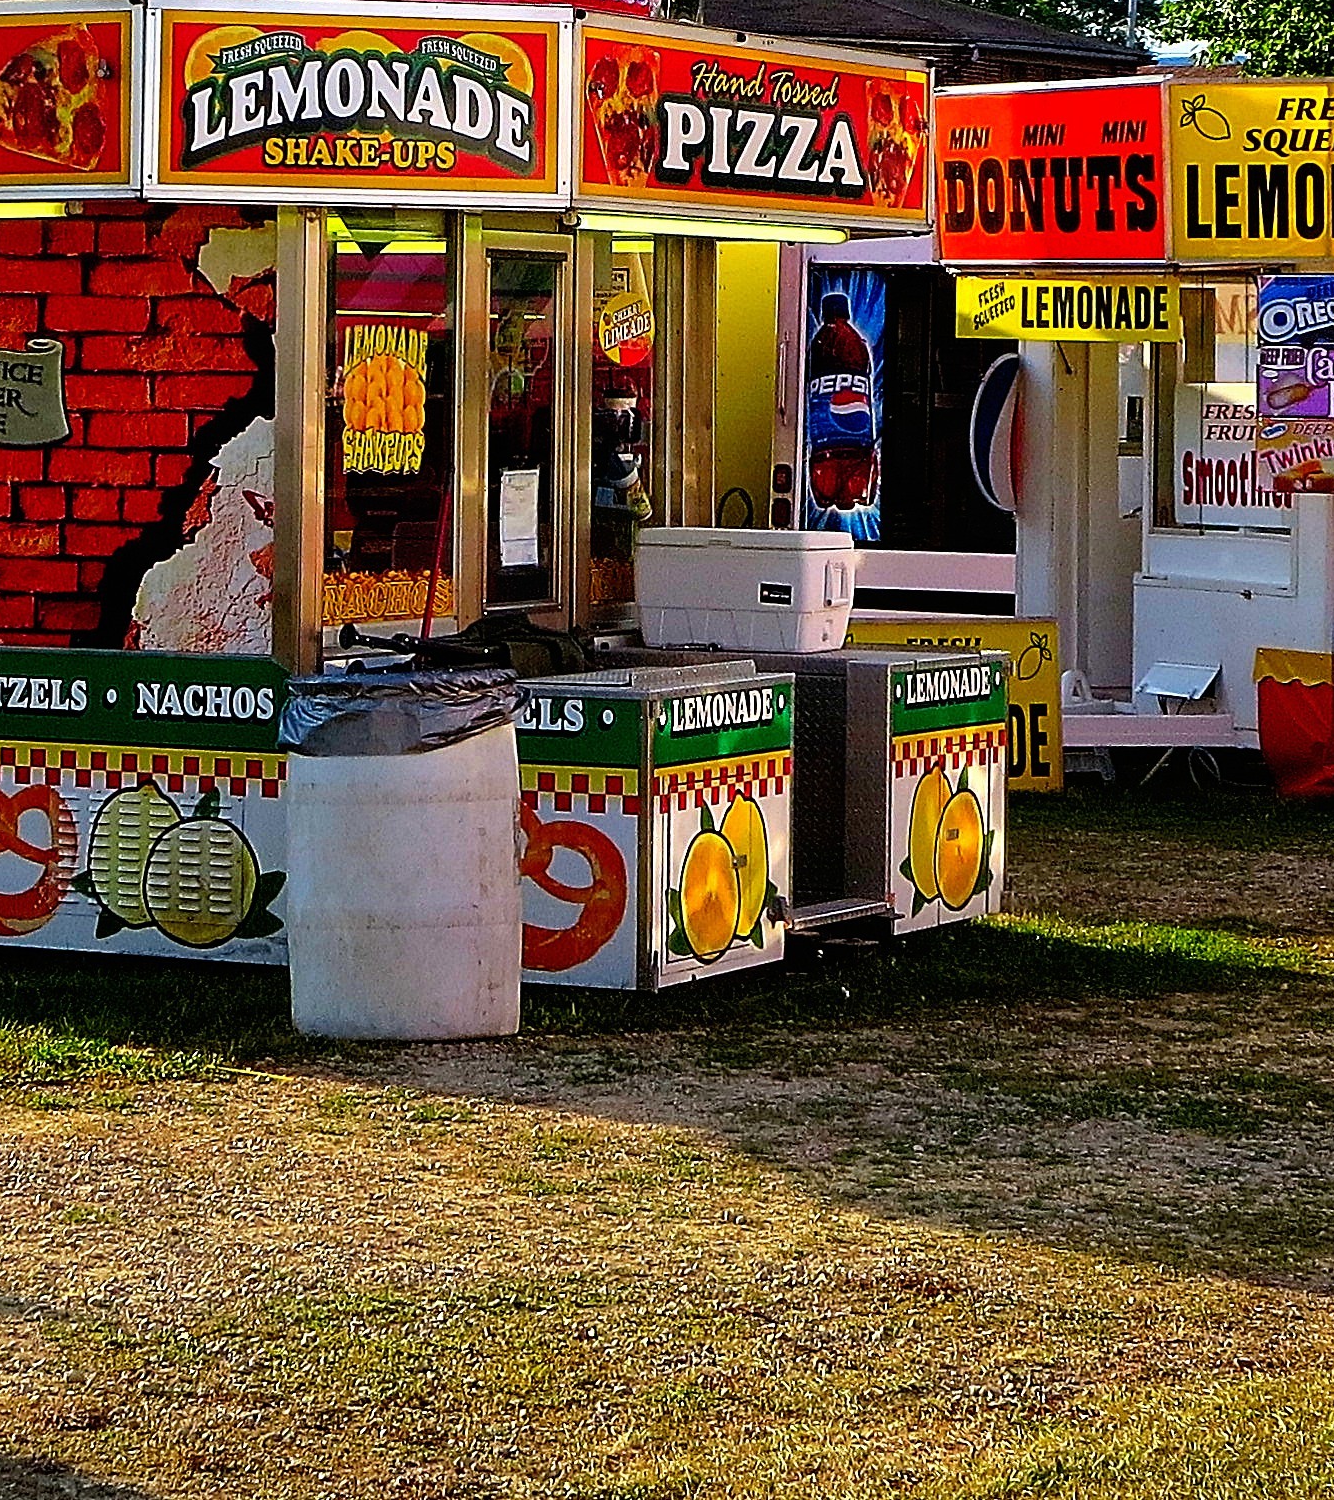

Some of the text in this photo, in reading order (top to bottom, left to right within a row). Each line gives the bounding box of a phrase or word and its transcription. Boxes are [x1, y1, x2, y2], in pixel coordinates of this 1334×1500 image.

[222, 33, 303, 64] FRESH SQUEEZED
[421, 38, 499, 74] FRESH SQUEEZED
[693, 62, 839, 107] Hand Tossed
[191, 58, 530, 160] LEMONADE
[663, 103, 865, 186] PIZZA
[949, 120, 1147, 148] MINI MINI MINI
[264, 138, 456, 170] SHAKE-UPS
[943, 154, 1160, 235] DONUTS
[978, 282, 1005, 307] FRESH
[1022, 286, 1168, 329] LEMONADE
[604, 312, 651, 350] LIMEADE
[345, 325, 428, 380] LEMONADE
[1202, 404, 1257, 420] FRES
[1293, 424, 1334, 437] DEEP
[343, 428, 424, 473] SHAKEUPS
[1205, 425, 1256, 441] FRUI
[323, 579, 452, 620] NACHOS
[136, 681, 274, 721] NACHOS
[906, 667, 990, 704] LEMONADE
[672, 688, 773, 732] LEMONADE
